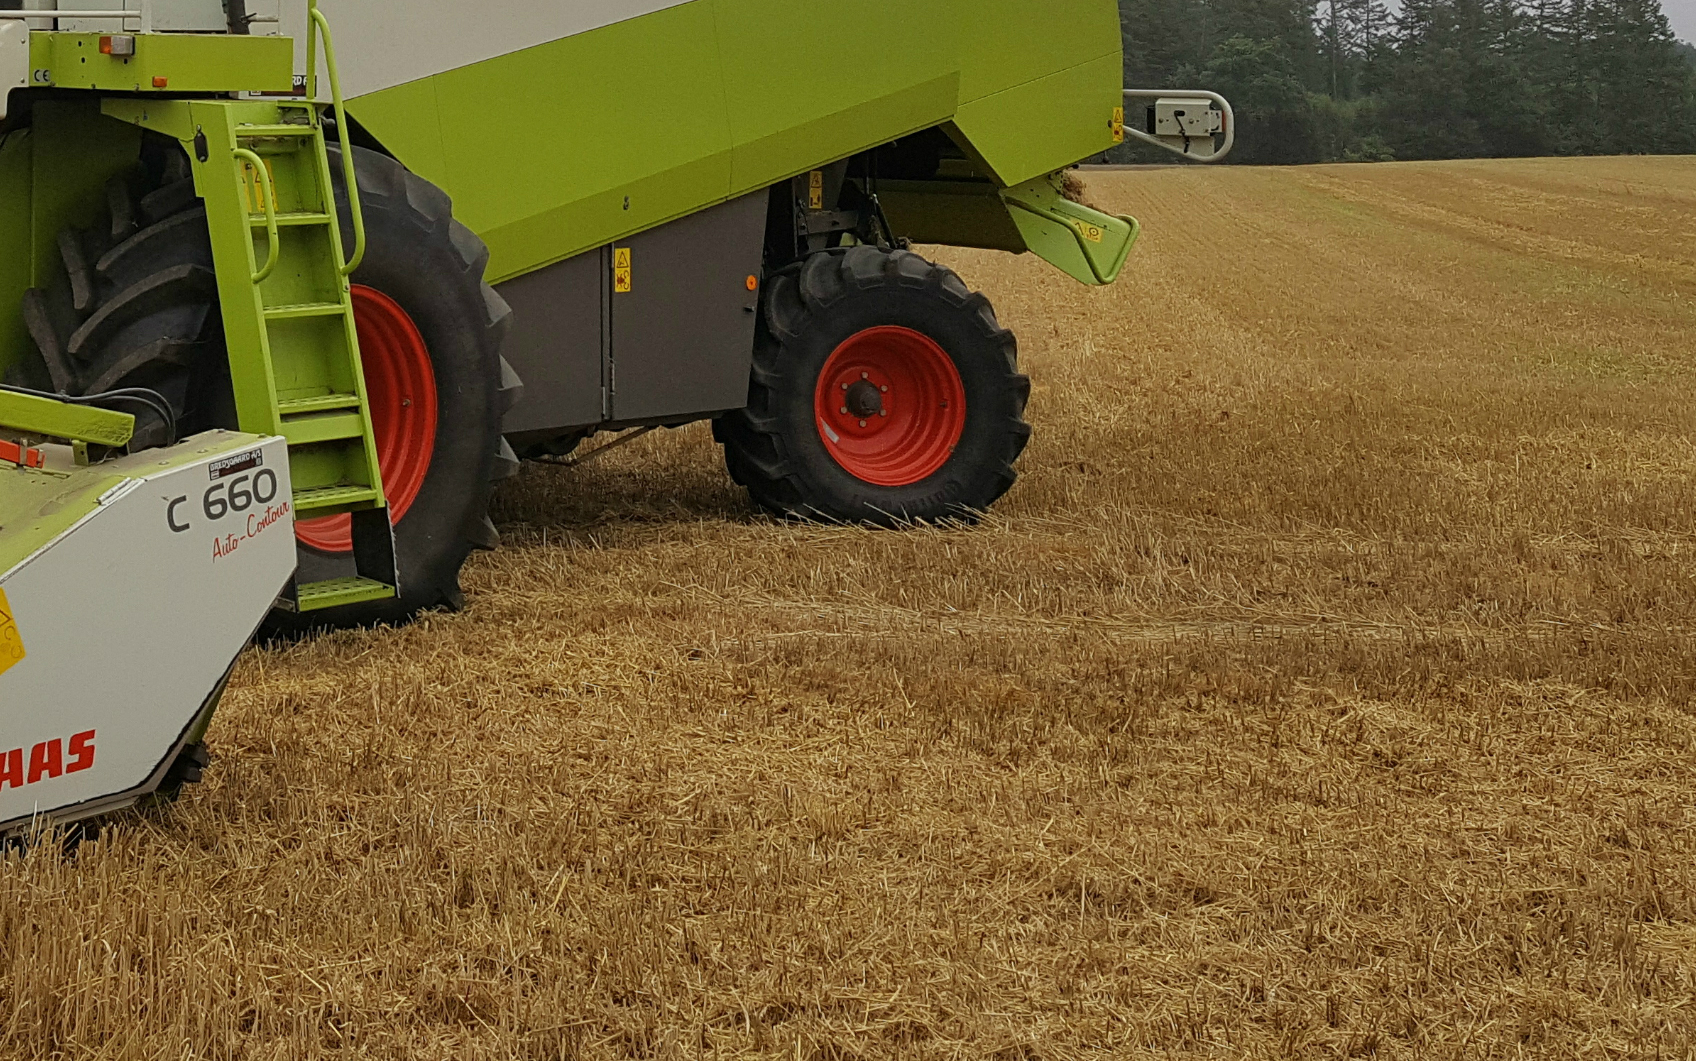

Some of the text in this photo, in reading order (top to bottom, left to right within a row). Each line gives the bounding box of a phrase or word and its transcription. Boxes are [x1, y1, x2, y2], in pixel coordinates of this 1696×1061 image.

[34, 69, 49, 82] CE
[167, 468, 278, 533] C 660
[212, 501, 290, 563] Auto-Contour
